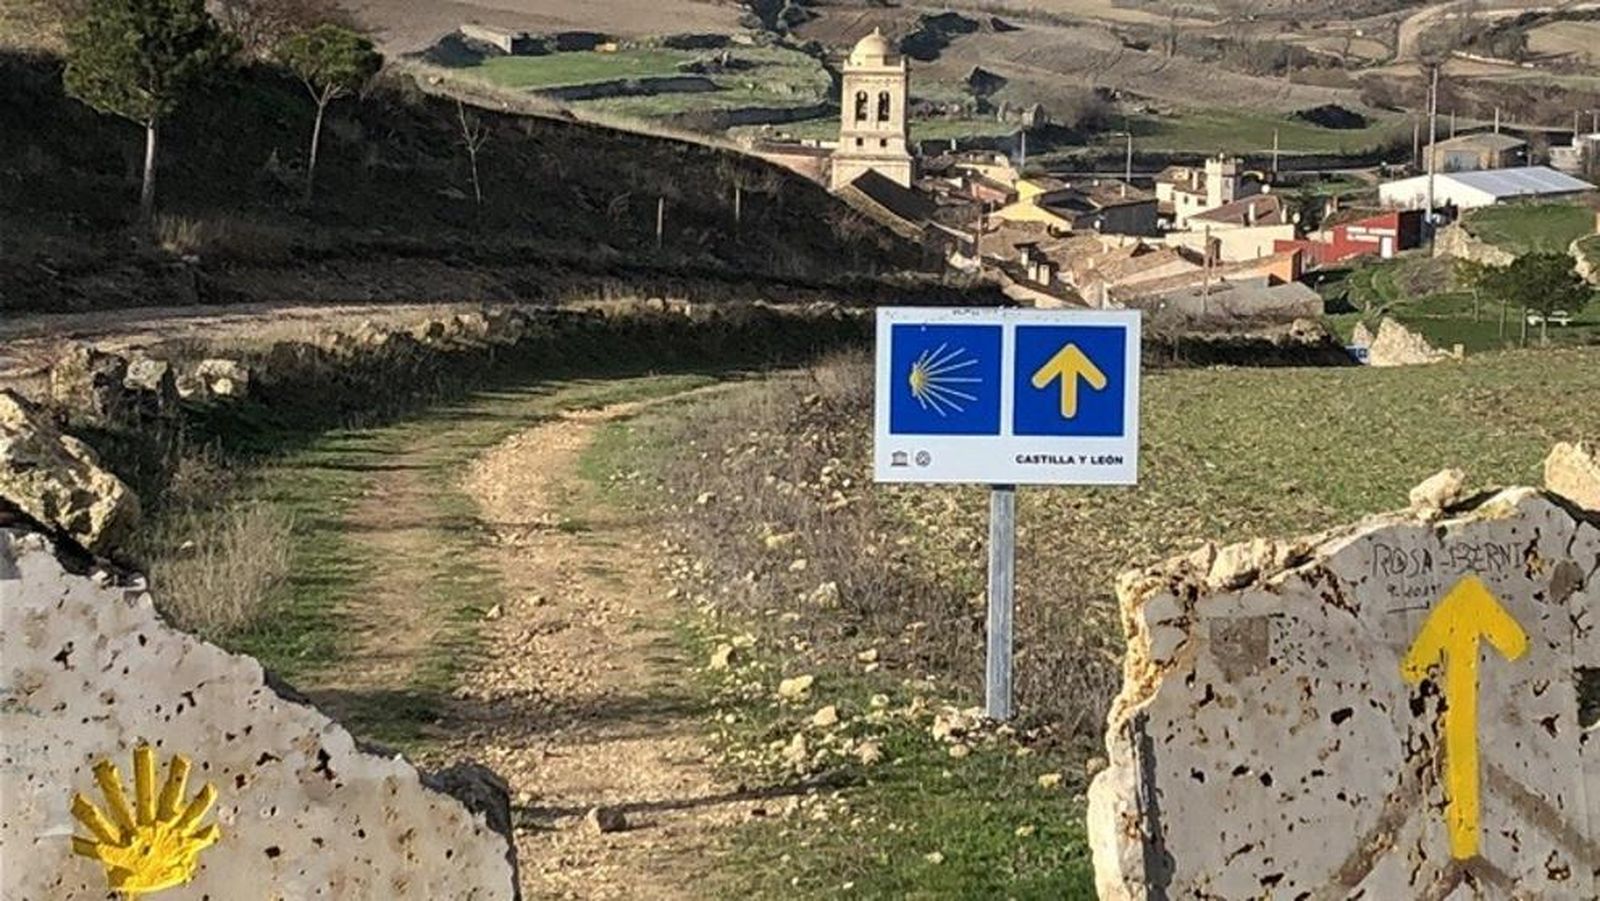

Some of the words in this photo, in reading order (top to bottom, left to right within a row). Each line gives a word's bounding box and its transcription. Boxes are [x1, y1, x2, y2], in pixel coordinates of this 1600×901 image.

[1015, 454, 1075, 465] CASTILLA
[1079, 455, 1087, 465] Y
[1091, 454, 1123, 466] LEÓN
